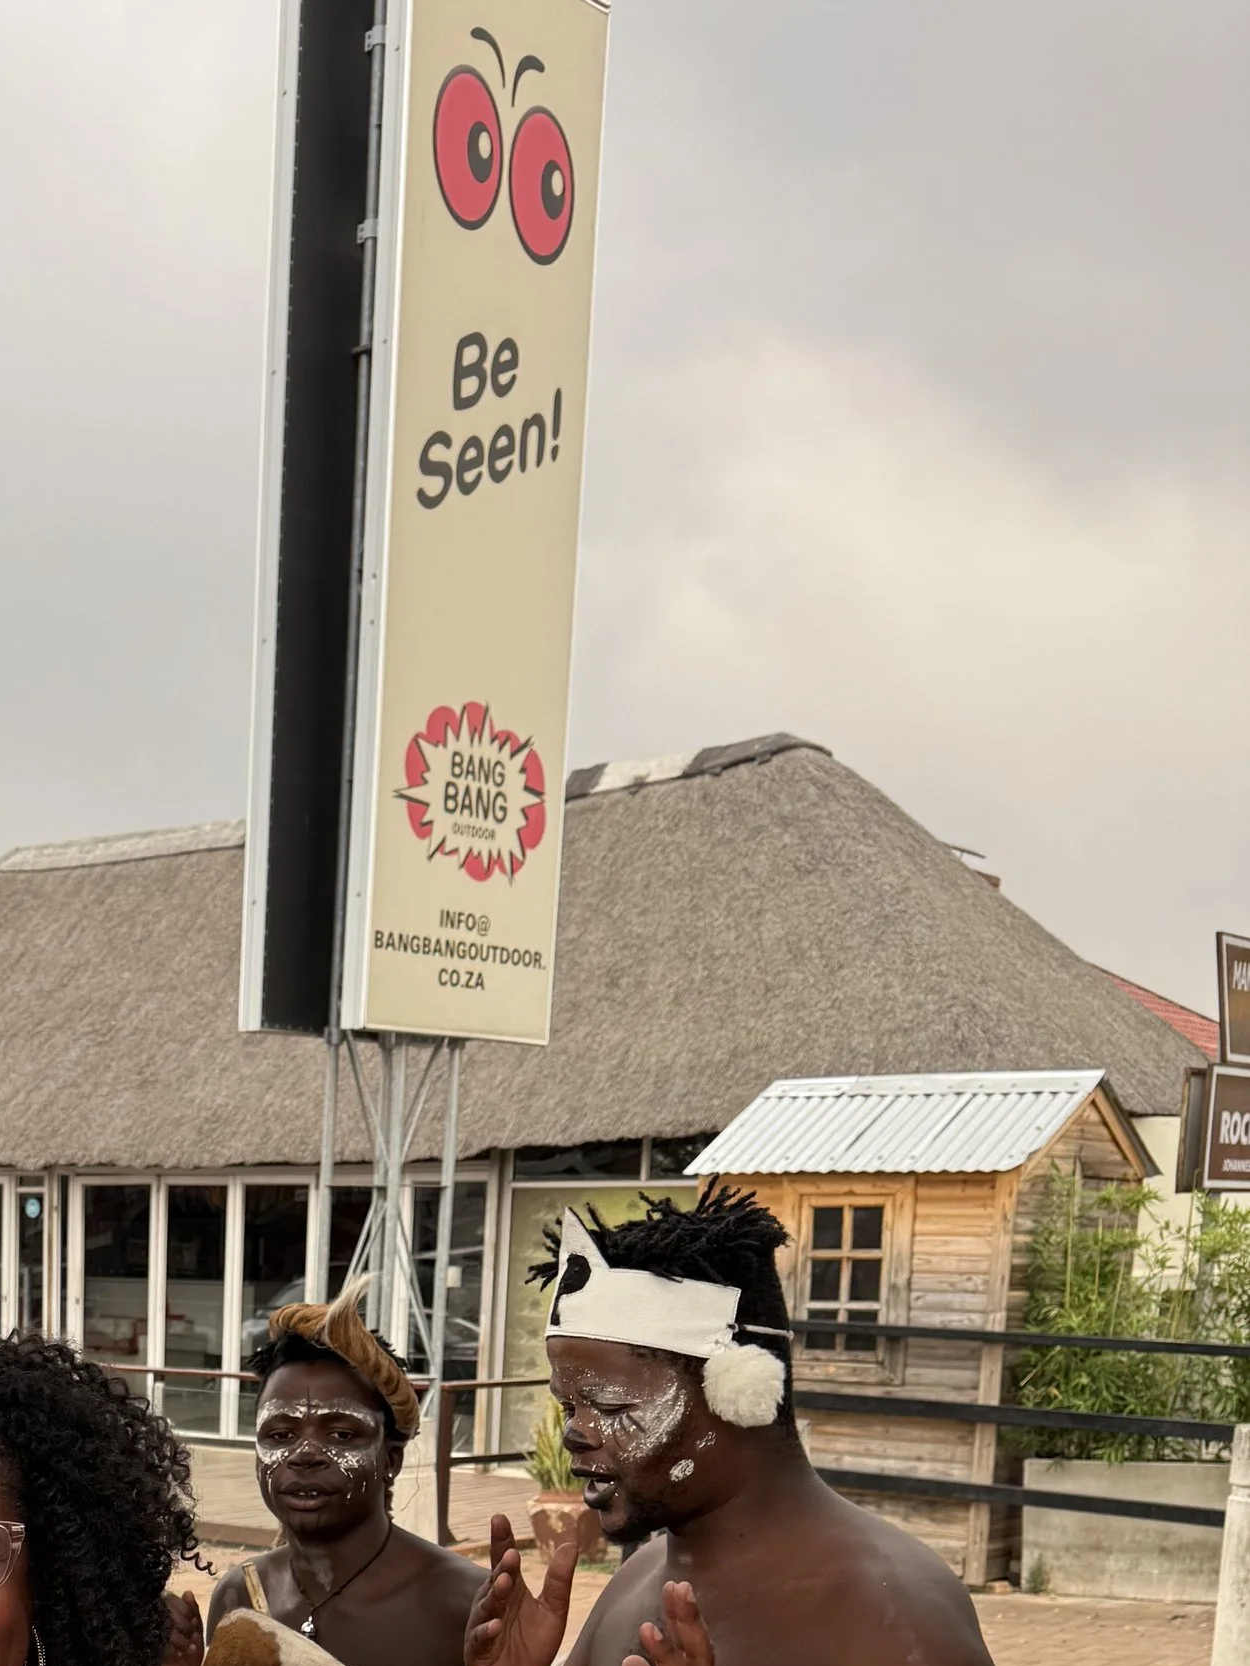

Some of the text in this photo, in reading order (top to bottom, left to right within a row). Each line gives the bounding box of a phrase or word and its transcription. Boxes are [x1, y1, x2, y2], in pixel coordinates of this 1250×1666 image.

[452, 331, 519, 411] Be
[416, 387, 562, 509] Seen!
[451, 751, 506, 788] BANG
[444, 781, 507, 824] BANG
[452, 822, 496, 841] OUTDOOR
[439, 909, 491, 936] INFO@
[374, 930, 547, 970] BANGBANGOUTDOOR.
[438, 970, 485, 991] CO.ZA
[1219, 1110, 1250, 1146] ROC
